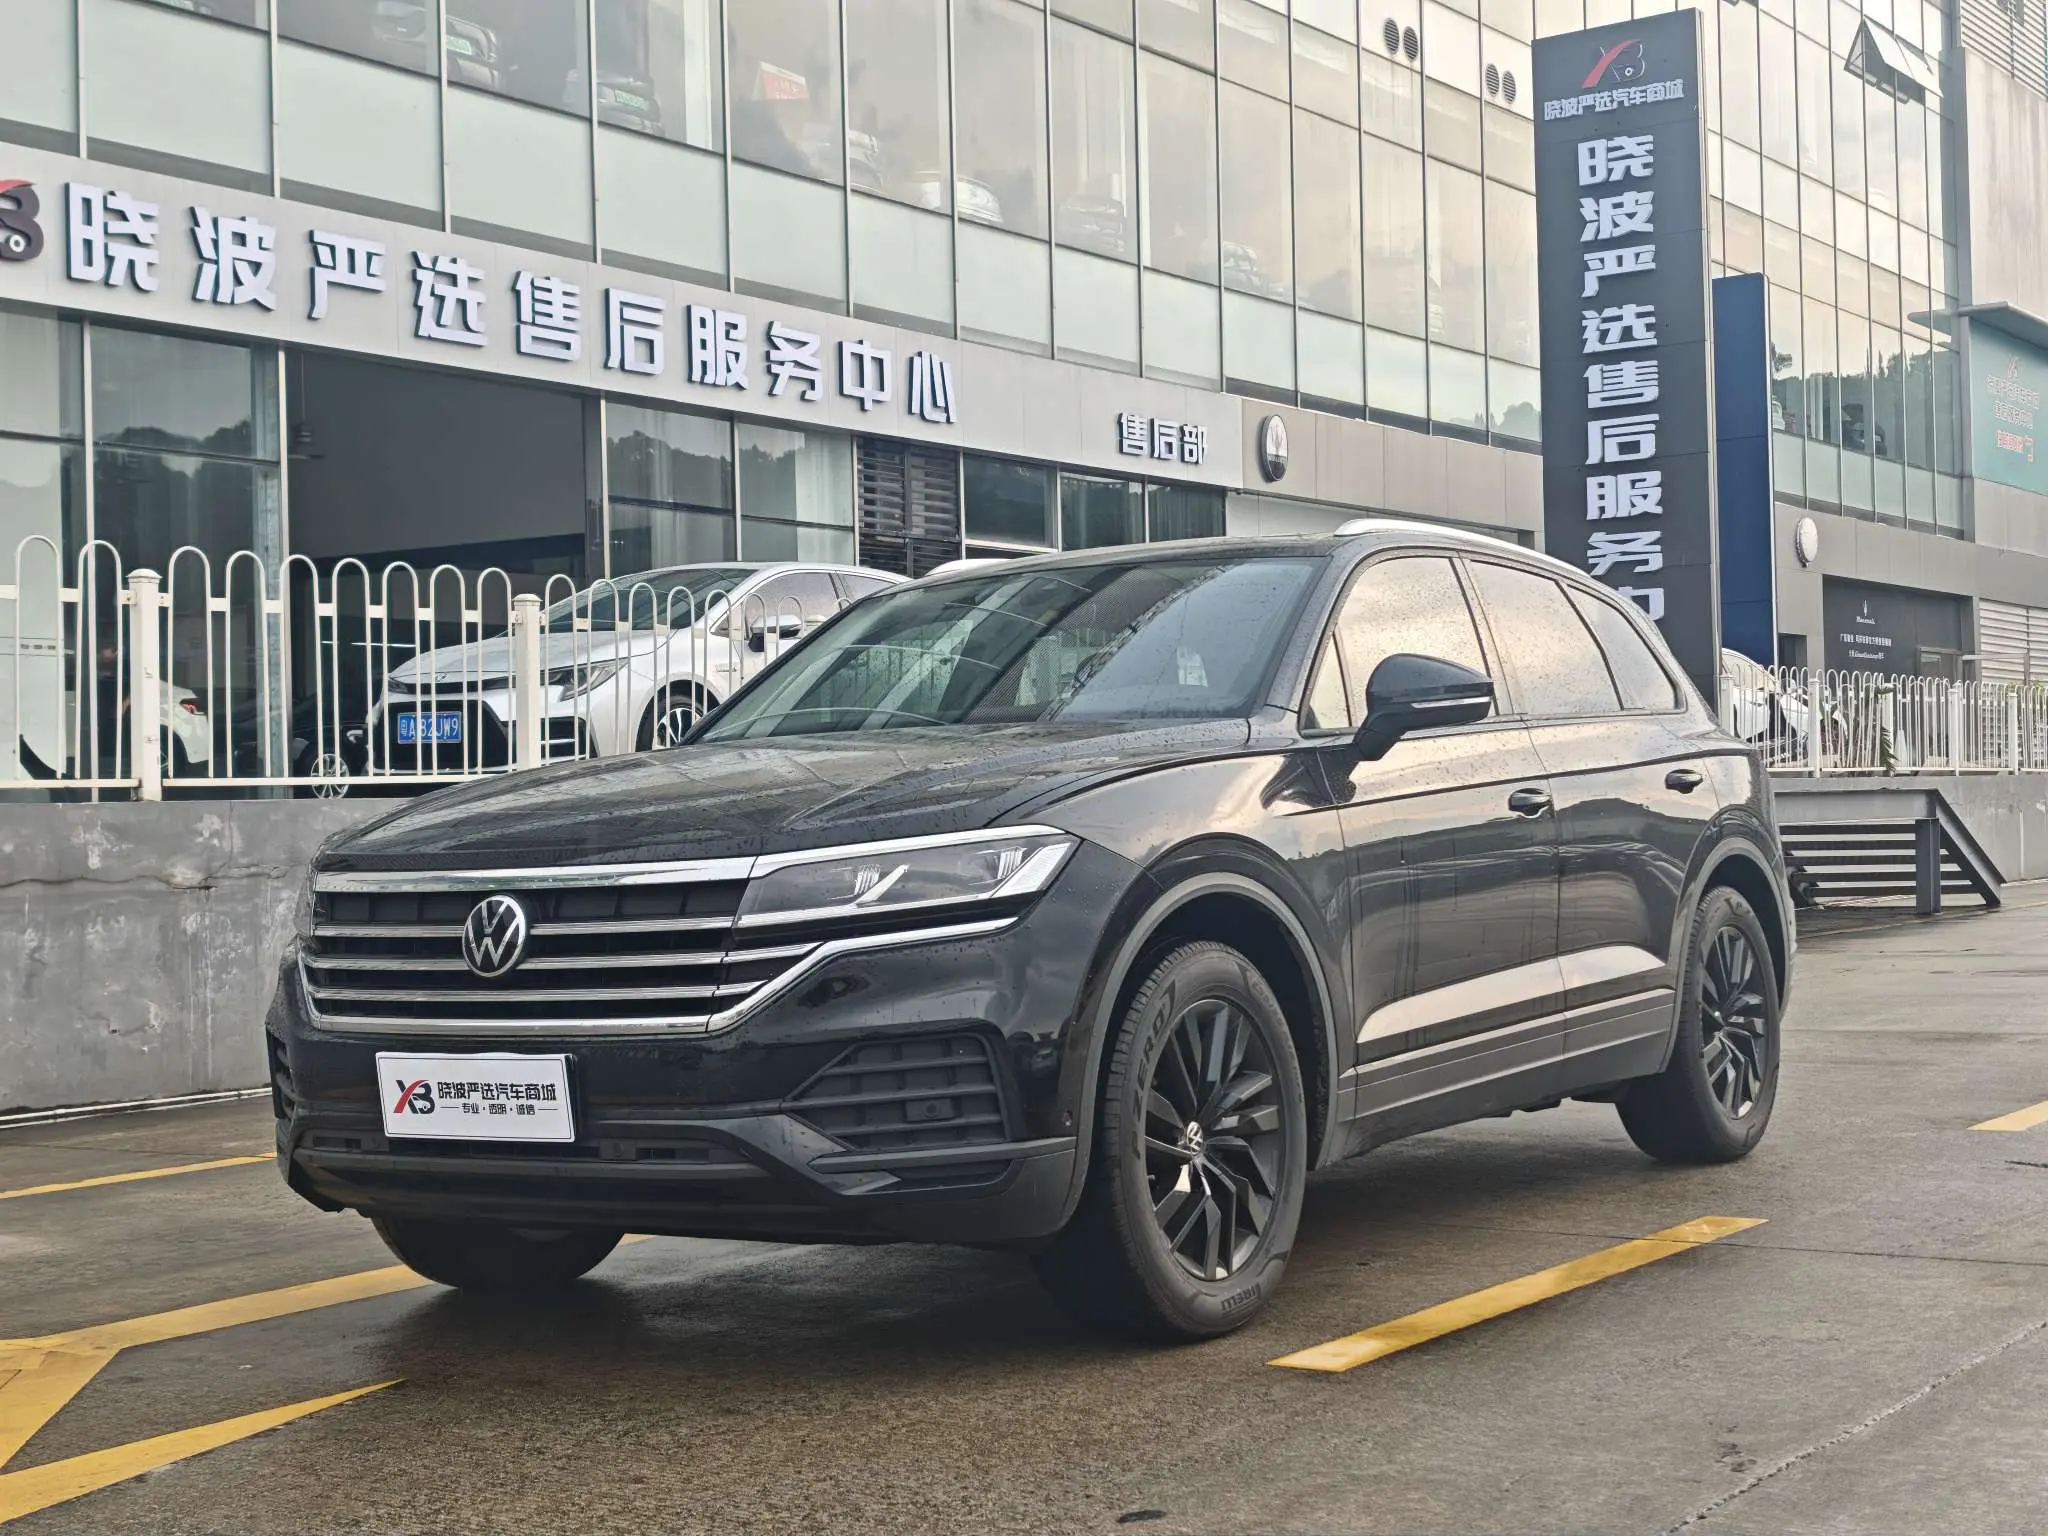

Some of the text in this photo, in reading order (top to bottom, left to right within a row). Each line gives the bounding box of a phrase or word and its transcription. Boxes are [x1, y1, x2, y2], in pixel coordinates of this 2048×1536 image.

[1544, 79, 1685, 120] 晓波严选汽车商城
[65, 181, 957, 424] 晓波严选售后服务中心
[1118, 412, 1209, 466] 售后部
[437, 1081, 557, 1101] 晓波严选汽车商城
